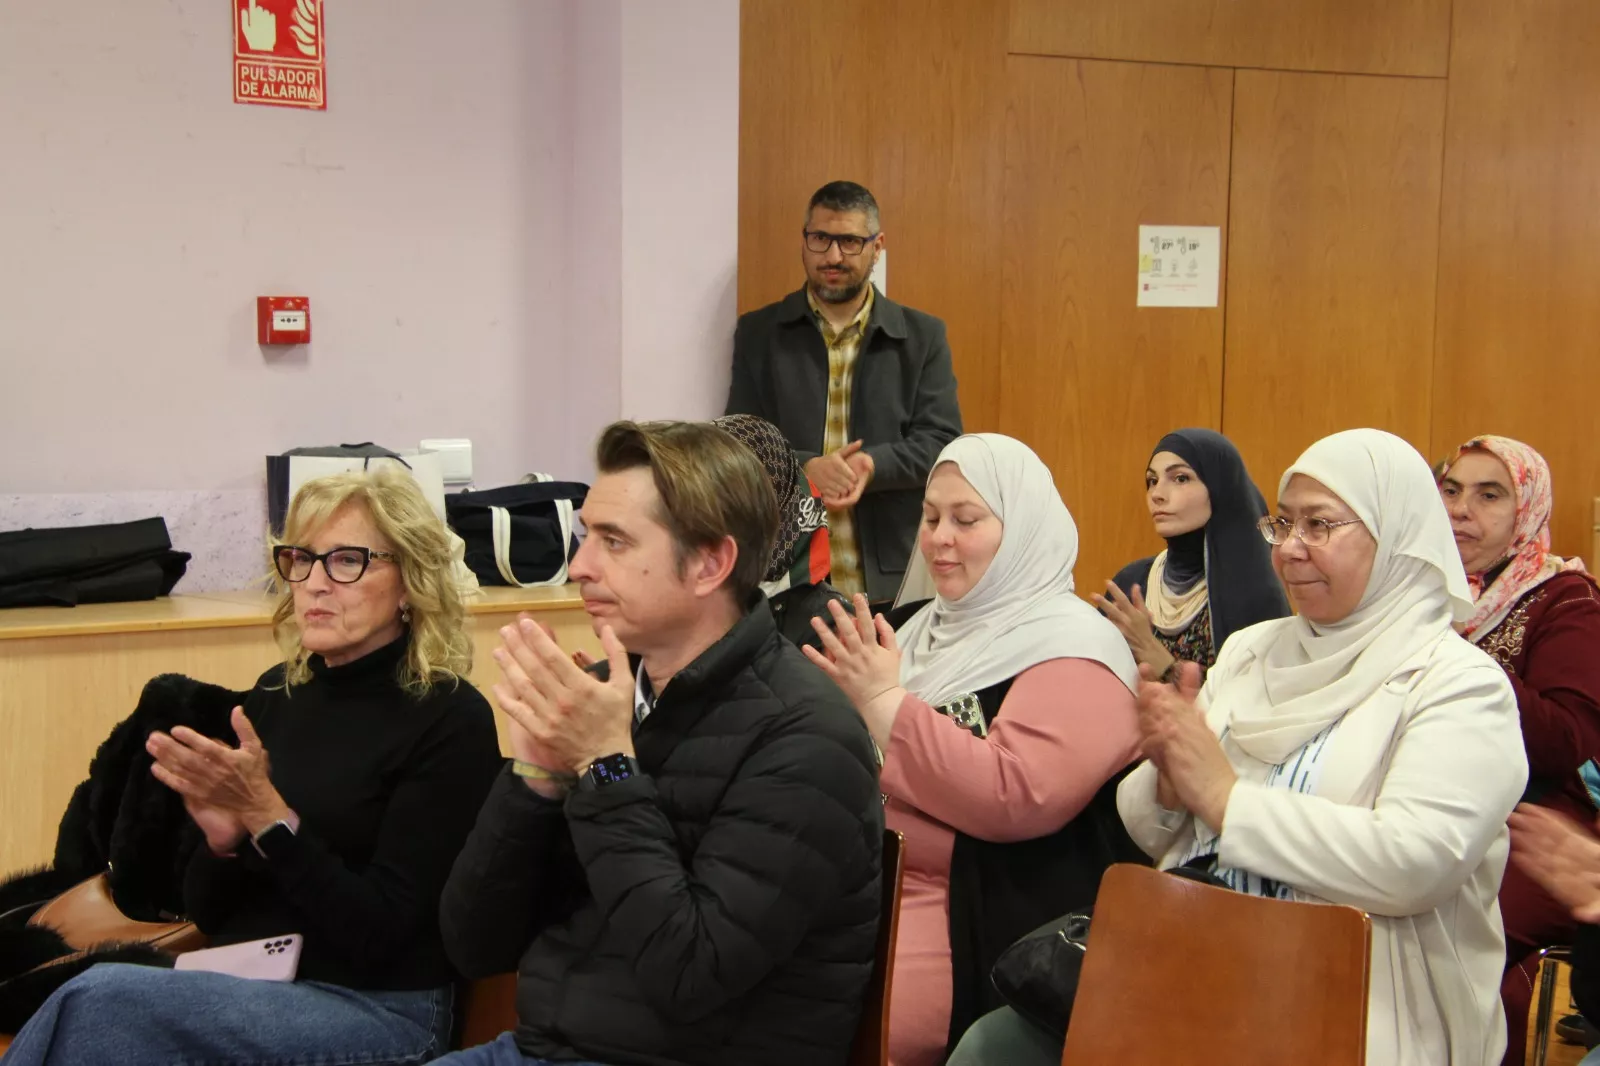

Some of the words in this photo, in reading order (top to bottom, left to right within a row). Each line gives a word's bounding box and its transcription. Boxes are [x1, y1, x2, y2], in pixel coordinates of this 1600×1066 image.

[241, 66, 316, 85] PULSADOR
[241, 81, 259, 96] DE
[262, 83, 317, 100] ALARMA
